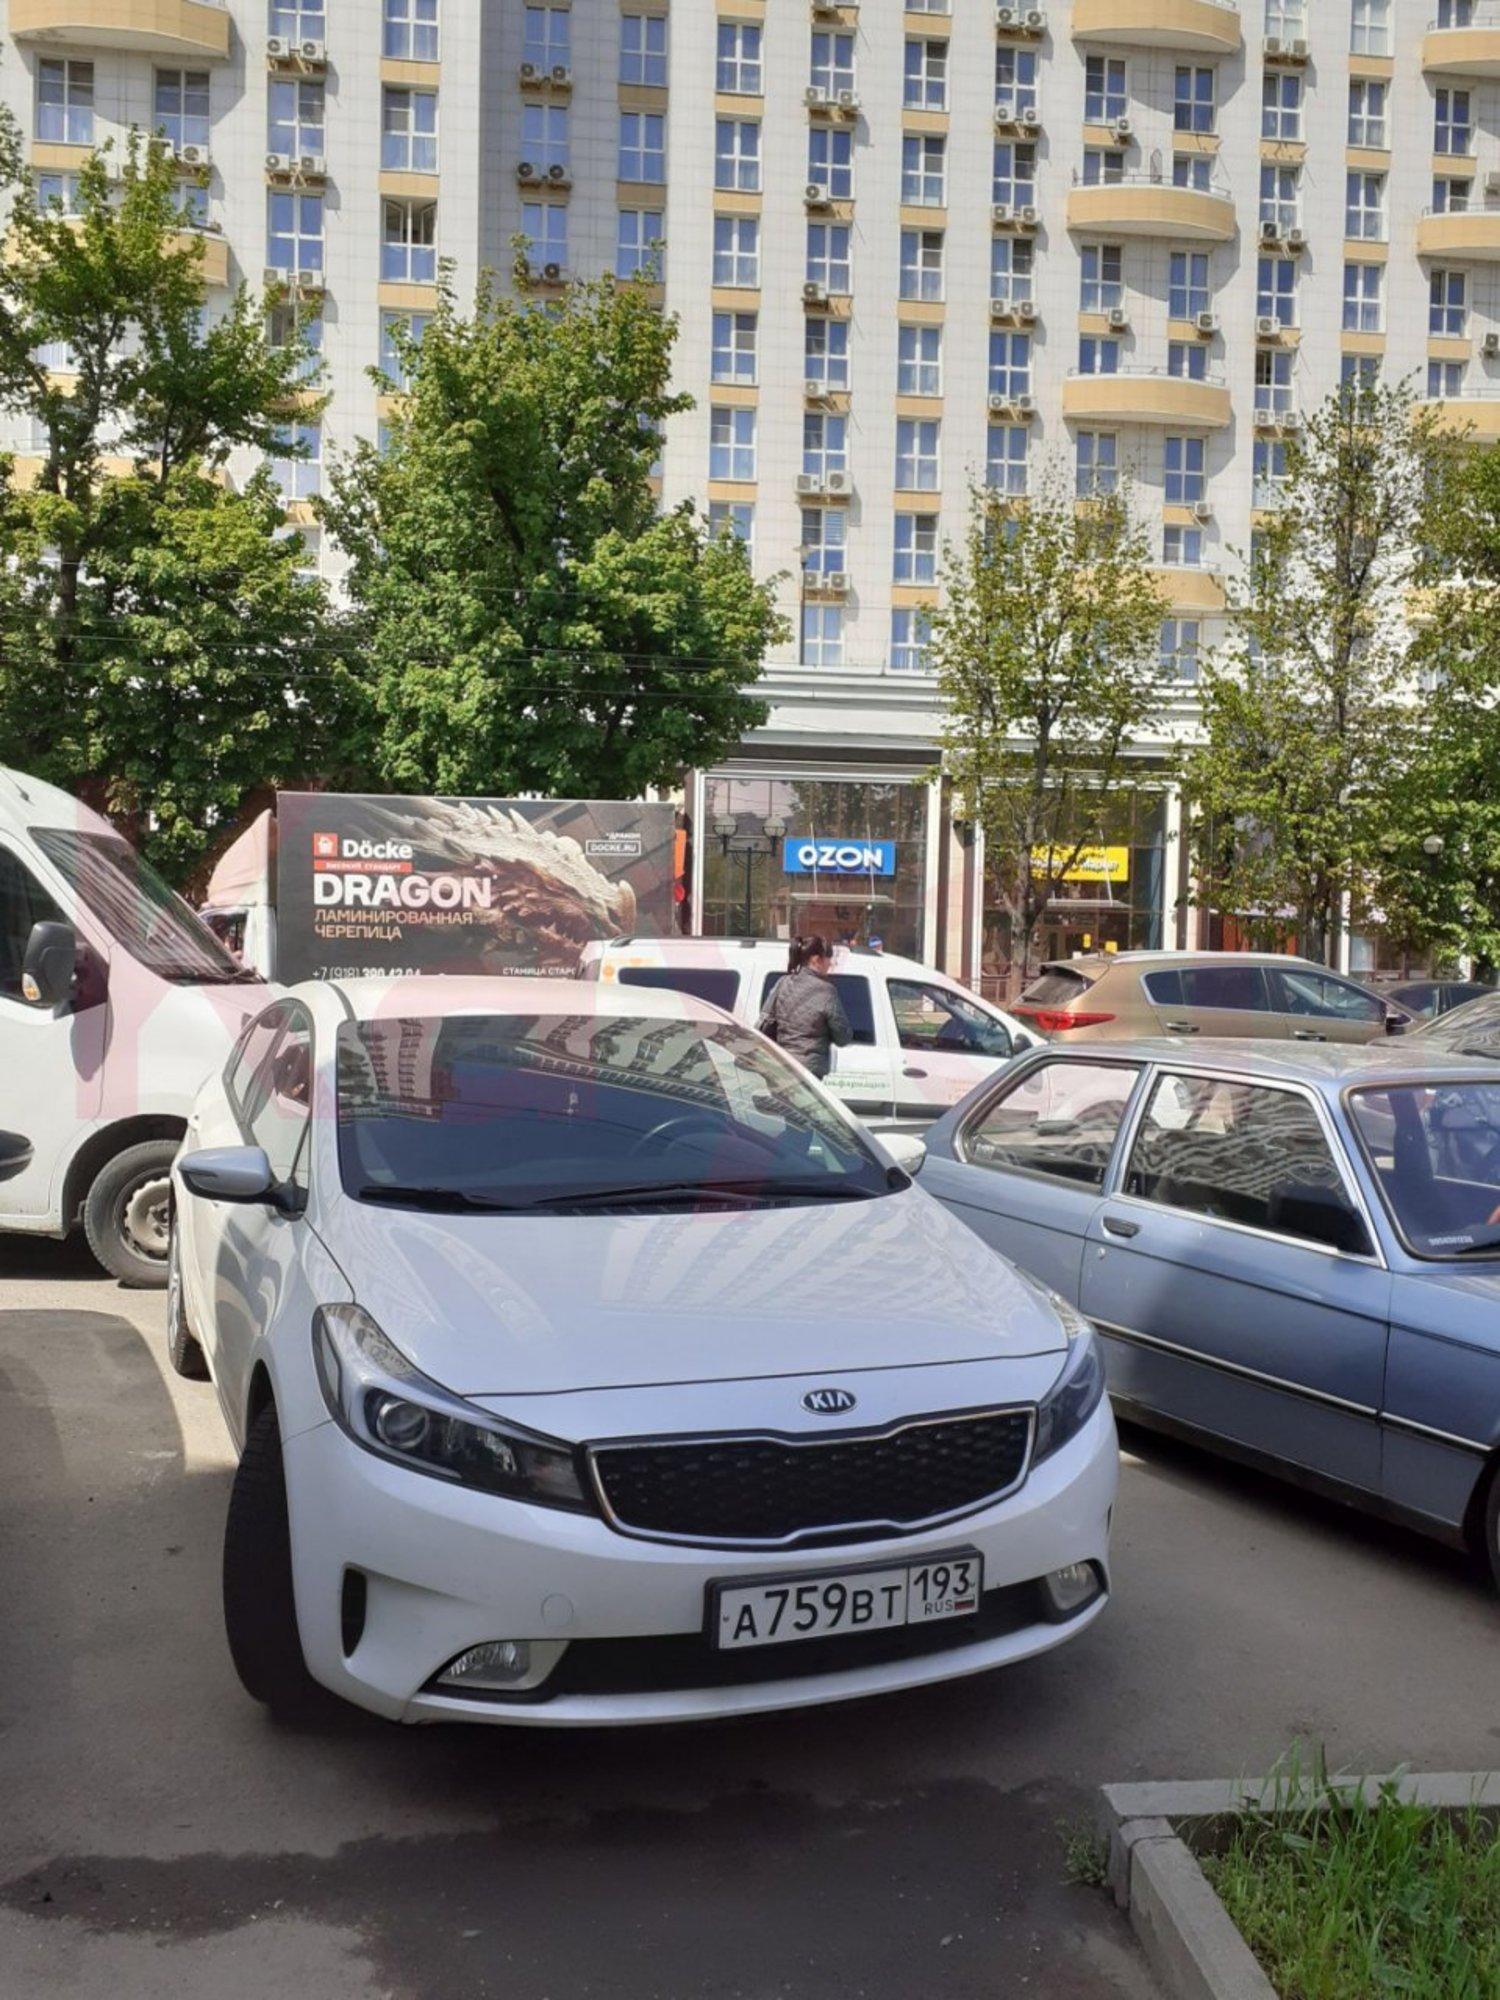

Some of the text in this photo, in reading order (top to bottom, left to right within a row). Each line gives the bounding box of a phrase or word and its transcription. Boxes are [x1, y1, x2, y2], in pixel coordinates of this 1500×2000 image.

[342, 838, 413, 859] Döcke
[798, 845, 882, 868] OZON
[313, 873, 492, 908] DRAGON
[315, 909, 473, 924] ЛАМИНИРОВАННАЯ
[314, 924, 402, 941] ЧЕРЕПИЦА
[502, 966, 547, 977] СТАНИЦА
[810, 1391, 851, 1409] KIA
[913, 1562, 971, 1601] 193
[924, 1598, 954, 1616] RUS
